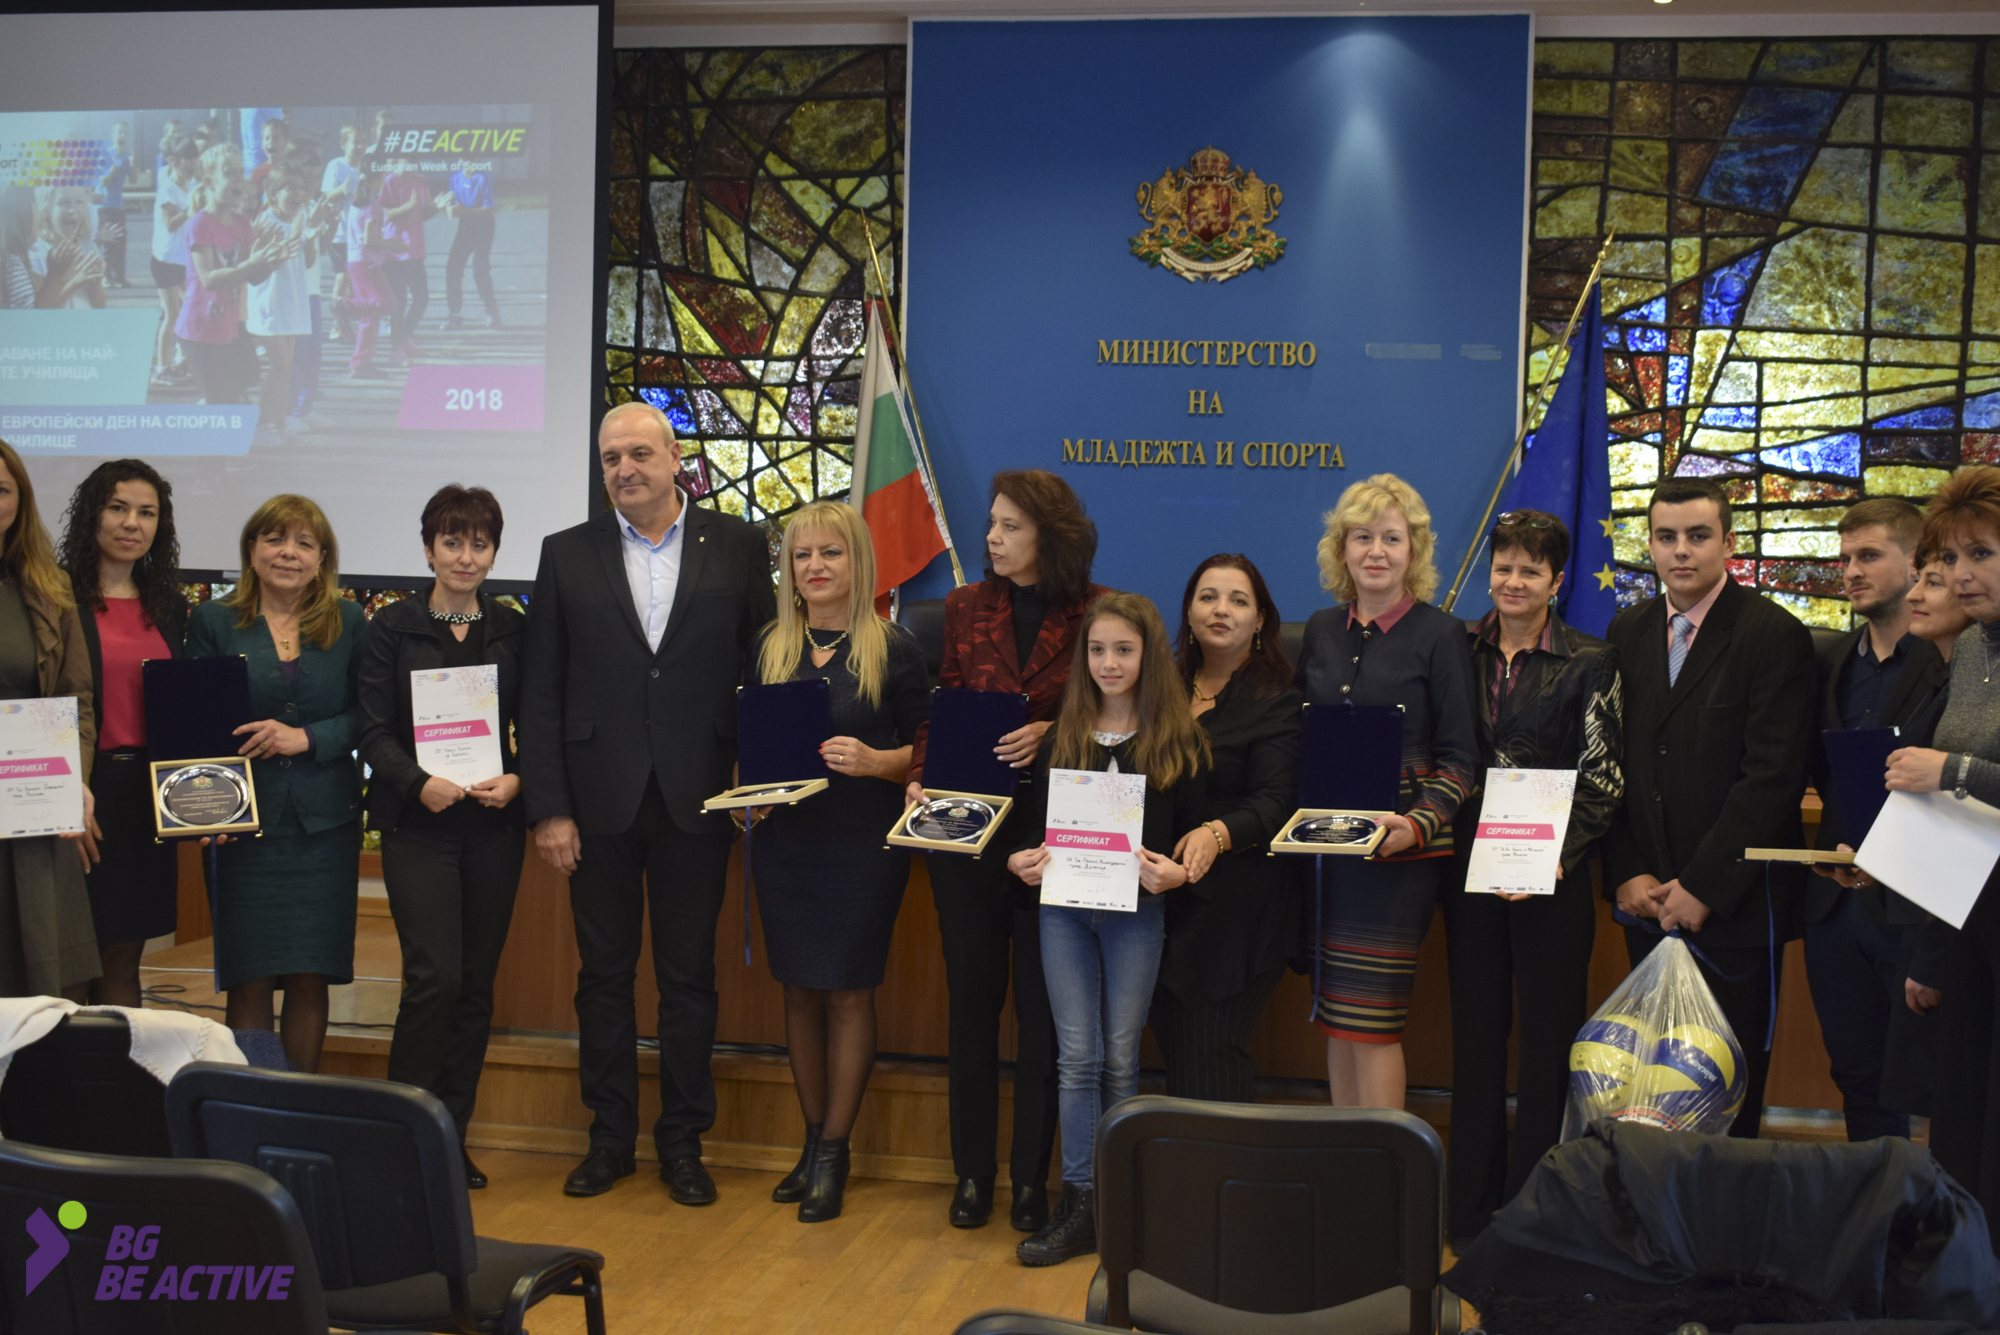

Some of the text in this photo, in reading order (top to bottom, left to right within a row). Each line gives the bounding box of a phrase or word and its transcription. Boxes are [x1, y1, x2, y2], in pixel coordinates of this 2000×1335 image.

[384, 128, 526, 153] #BEACTIVE
[0, 158, 19, 169] ort
[371, 160, 493, 173] European Week of Sport
[0, 343, 118, 362] АВАНЕ НА НАЙ-
[1097, 338, 1317, 367] МИНИСТЕРСТВО
[22, 365, 99, 381] УЧИЛИЩА
[445, 387, 503, 411] 2018
[1187, 390, 1225, 416] НА
[2, 412, 241, 430] ЕВРОПЕЙСКИ ДЕН НА СПОРТА В
[1061, 438, 1346, 469] МЛАДЕЖТА И СПОРТА
[424, 725, 472, 738] СЕРТИФИКАТ
[1056, 833, 1111, 846] СЕРТИФИКАТ
[1486, 827, 1537, 836] СЕРТИФИКАТ
